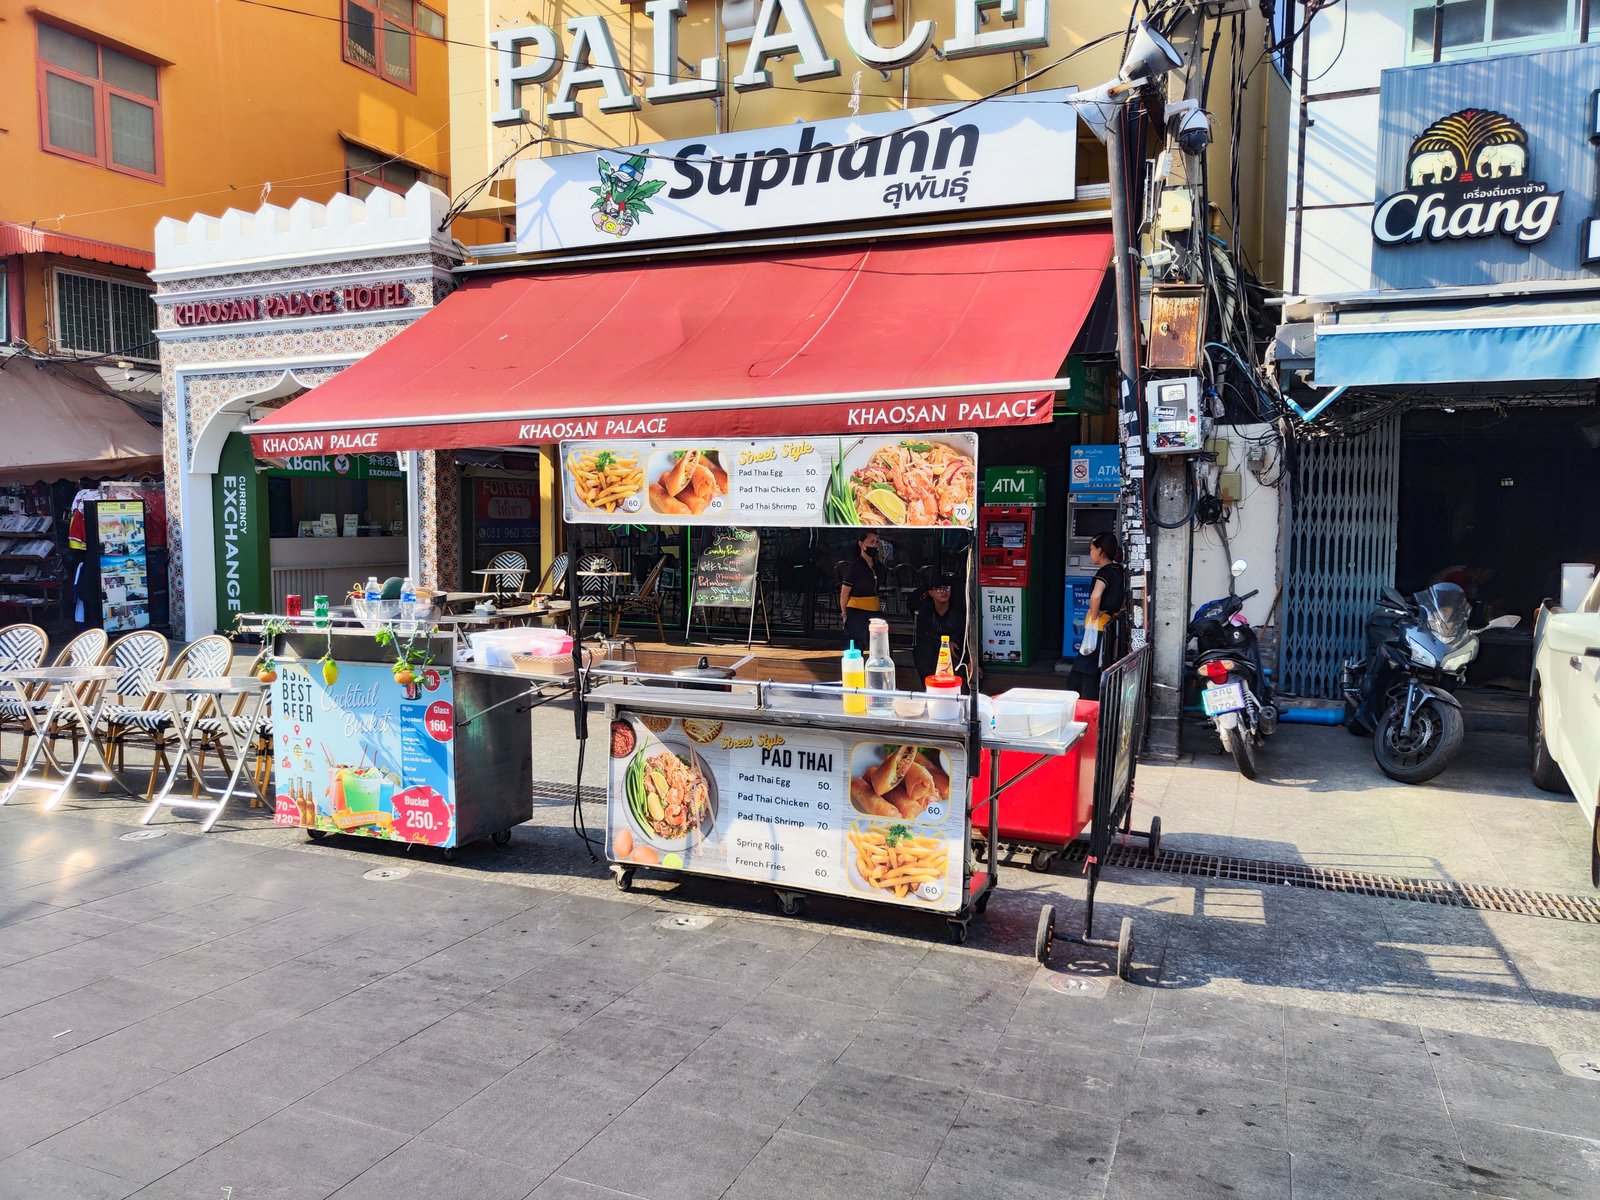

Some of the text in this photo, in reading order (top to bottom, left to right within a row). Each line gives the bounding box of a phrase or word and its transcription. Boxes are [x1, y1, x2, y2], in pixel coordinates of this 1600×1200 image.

[668, 123, 980, 207] Suphann
[1463, 184, 1545, 199] เครื่องดื่มตราช้าง
[1374, 192, 1560, 241] Chang
[174, 283, 407, 326] KHAOSAN PALACE HOTEL
[847, 398, 1038, 425] KHAOSAN PALACE
[518, 417, 667, 439] KHAOSAN PALACE
[263, 432, 378, 453] KHAOSAN PALACE
[738, 440, 814, 465] Street Style
[770, 469, 783, 478] Egg
[805, 468, 818, 476] 50.
[1097, 465, 1121, 476] ATM
[483, 480, 535, 496] FOR RENT
[770, 485, 800, 493] Chicken
[991, 478, 1025, 493] ATM
[238, 476, 247, 534] CURRENCY
[740, 502, 818, 511] Pad Thai Shrimp 70.
[956, 508, 969, 516] 70.
[223, 475, 241, 611] EXCHANGE
[988, 594, 1014, 604] THAI
[989, 605, 1016, 613] BAHT
[282, 682, 312, 702] BEST
[433, 705, 450, 715] Glass
[429, 719, 453, 732] 160.-
[721, 732, 785, 750] Street Style
[761, 747, 833, 772] PAD THAI
[739, 773, 832, 791] Pad Thai Egg 50.
[404, 795, 430, 807] Bucket
[737, 792, 832, 811] Pad Thai Chicken 60.
[406, 810, 444, 830] 250.-
[927, 806, 942, 816] 60.
[737, 811, 830, 831] Pad Thai Shrimp 70.
[736, 838, 829, 858] Spring Rolls 60.
[735, 857, 829, 878] French Fries 60.
[925, 886, 940, 895] 60.
